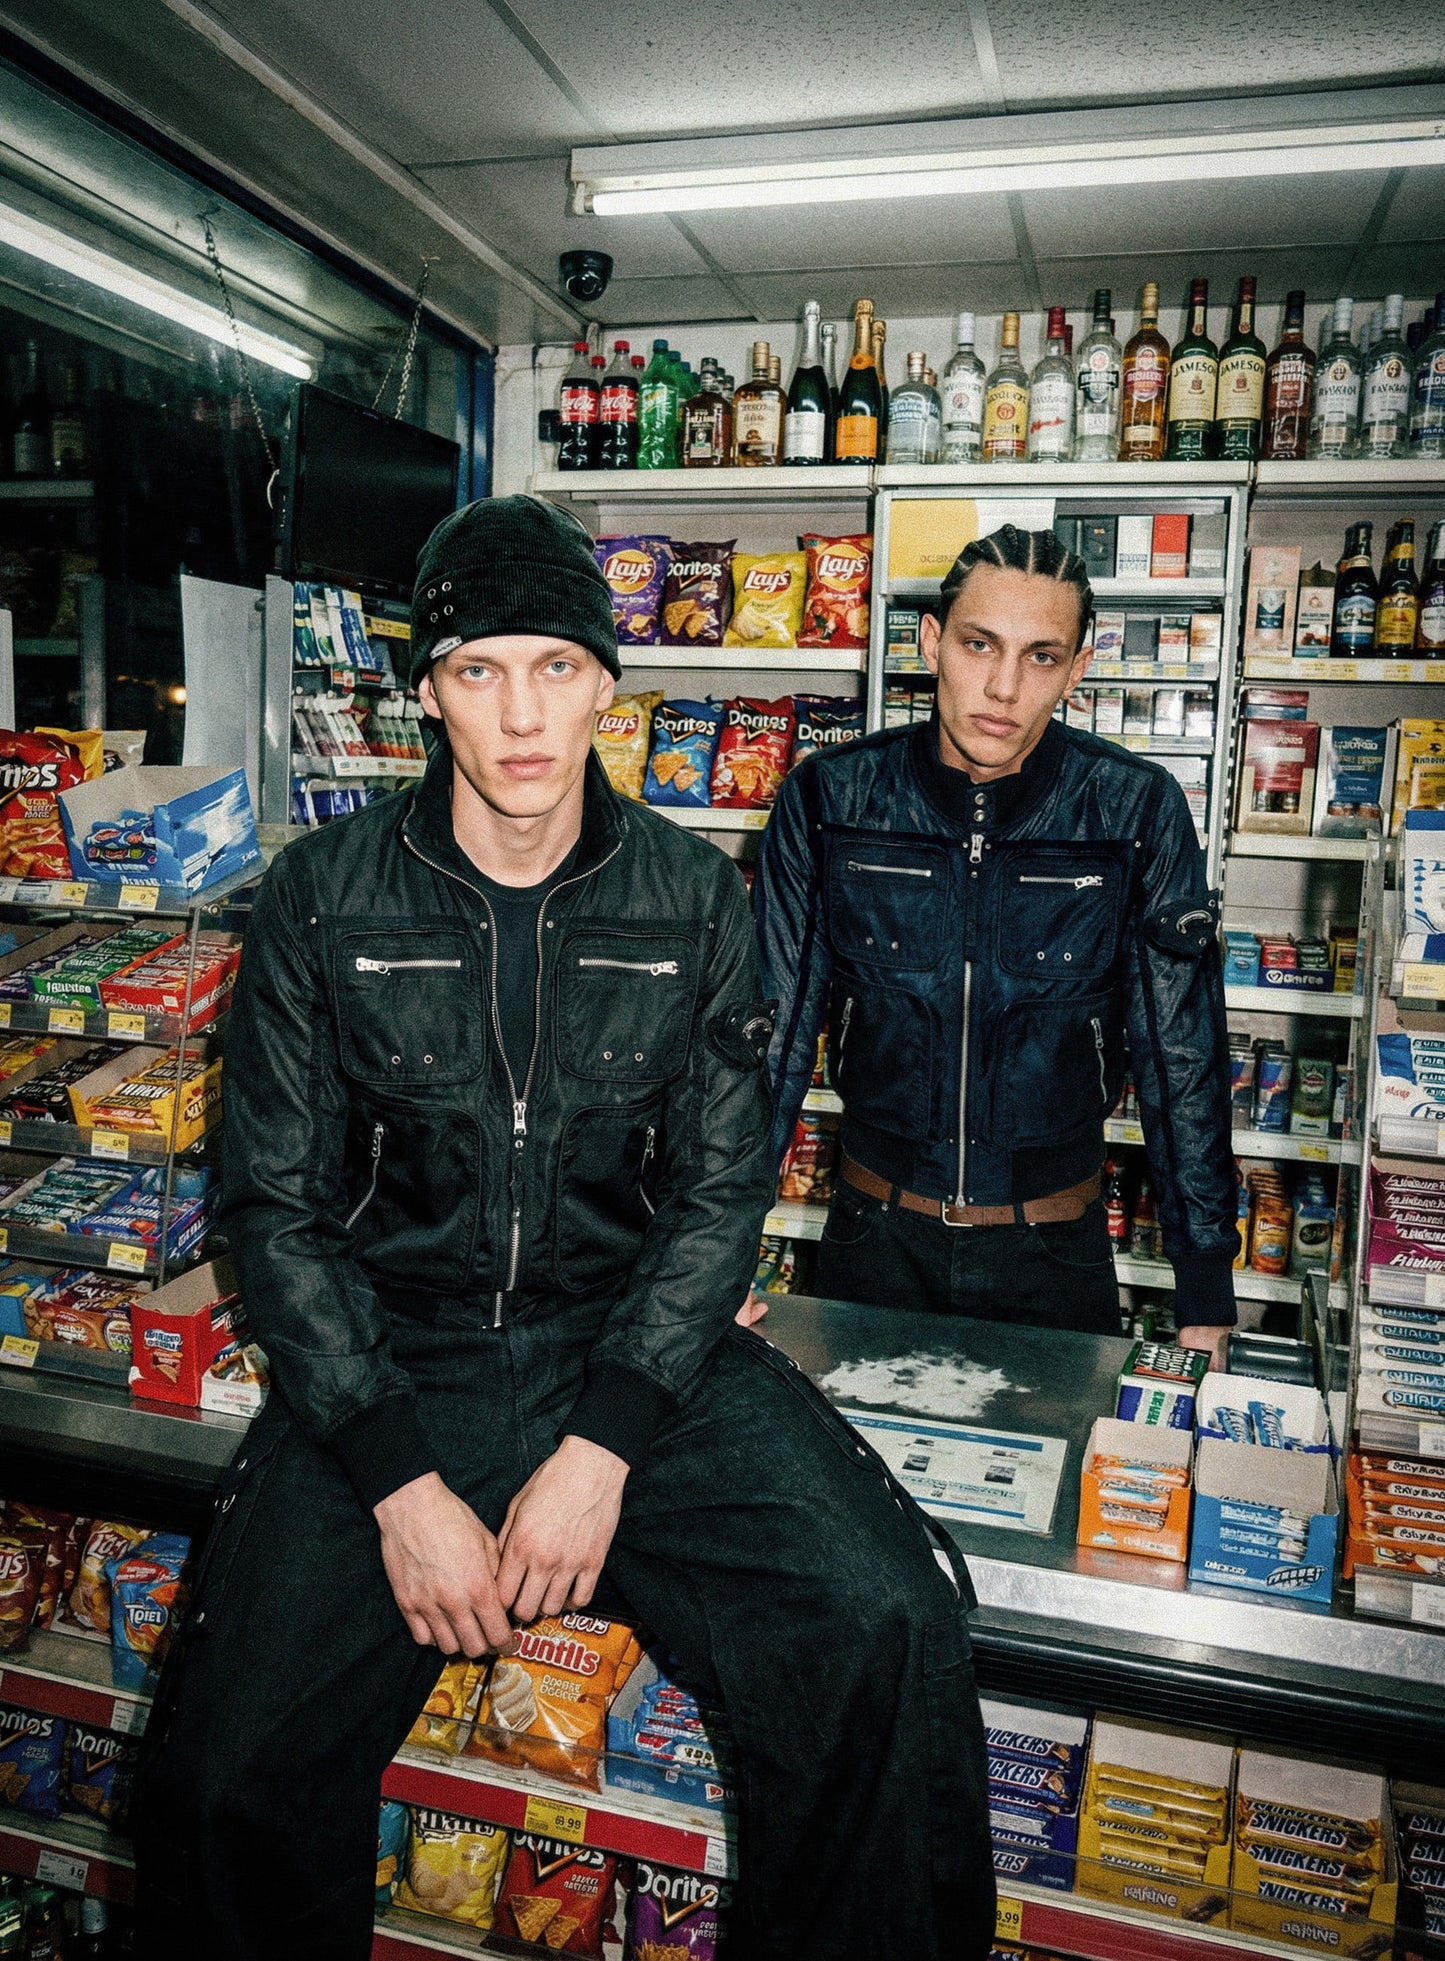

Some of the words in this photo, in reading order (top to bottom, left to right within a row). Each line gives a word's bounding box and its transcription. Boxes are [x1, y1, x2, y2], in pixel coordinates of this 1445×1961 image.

[654, 715, 718, 736] Doritos
[728, 709, 789, 731] Doritos
[798, 723, 862, 743] Doritos
[985, 1727, 1055, 1755] NICKERS
[1250, 1811, 1347, 1848] SNICKERS
[1248, 1844, 1346, 1878] SNICKERS
[637, 1862, 733, 1909] Doritos
